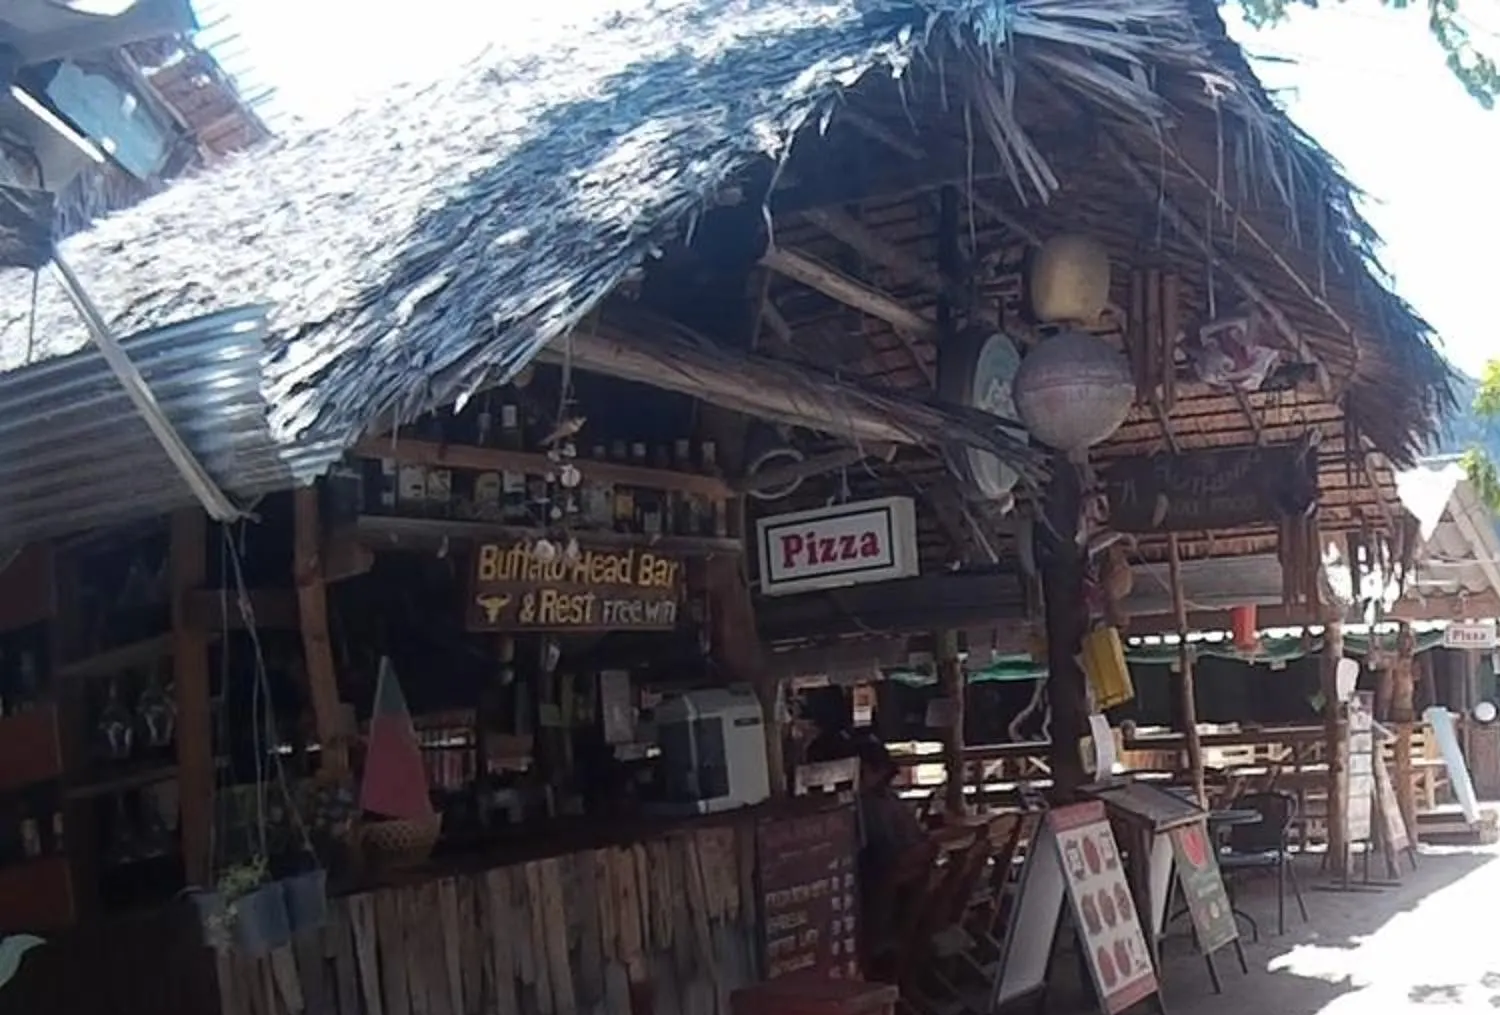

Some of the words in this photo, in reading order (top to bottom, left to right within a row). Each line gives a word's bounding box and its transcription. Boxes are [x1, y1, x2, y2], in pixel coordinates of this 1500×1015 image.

[479, 541, 566, 581] Buffalo
[572, 550, 631, 584] Head
[638, 553, 678, 588] Bar
[780, 531, 880, 569] Pizza
[518, 593, 536, 624] &
[538, 589, 596, 624] Rest
